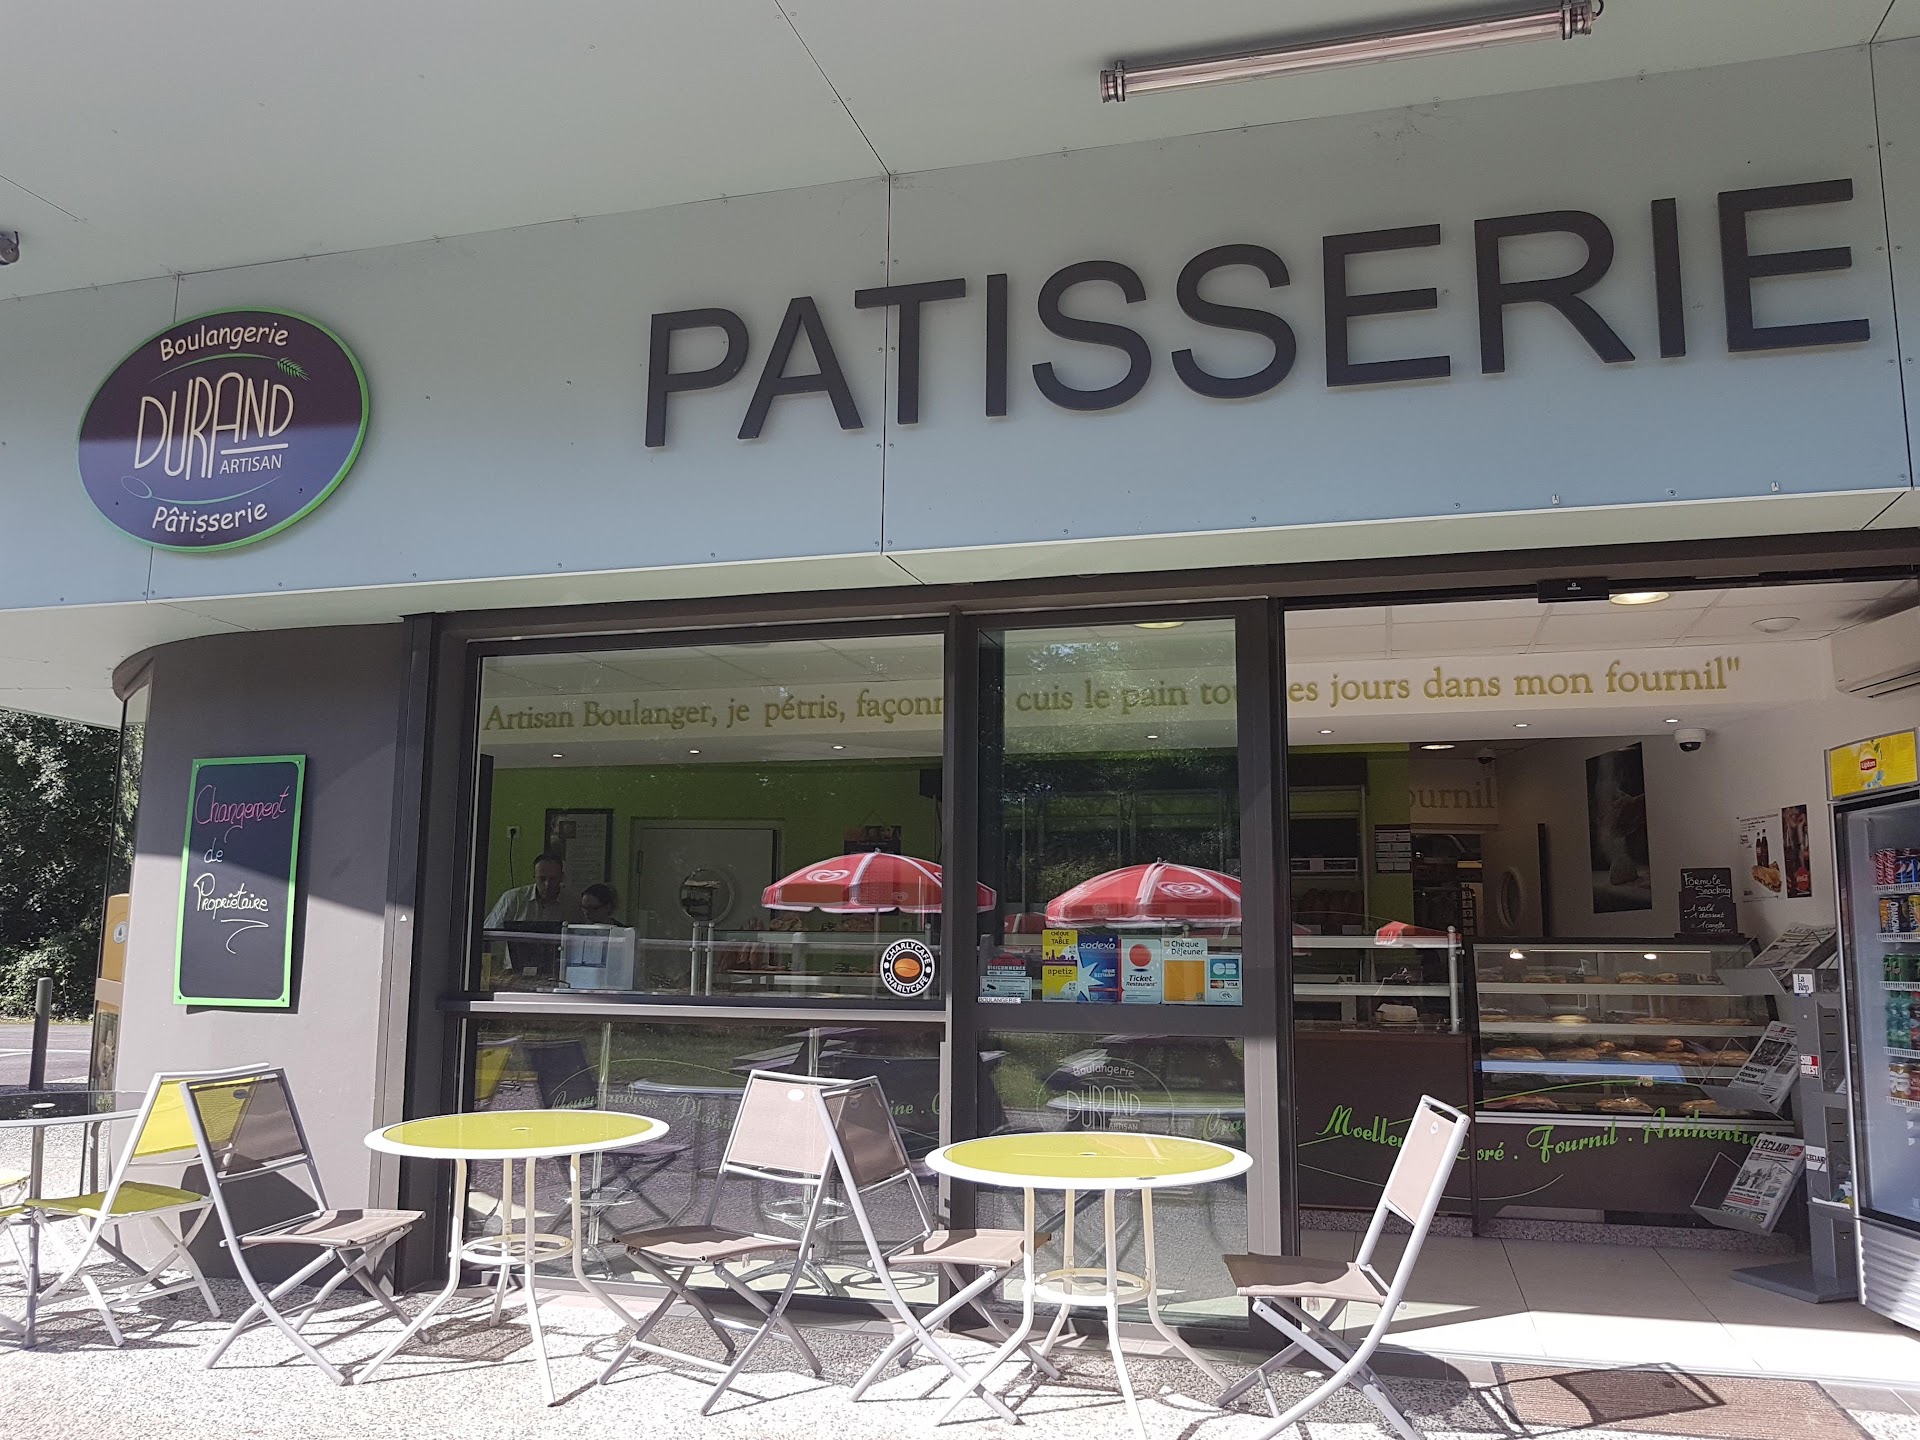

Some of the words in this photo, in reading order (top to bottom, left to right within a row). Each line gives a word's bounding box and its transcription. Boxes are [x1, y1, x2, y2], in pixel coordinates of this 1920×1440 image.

[645, 178, 1870, 448] PATISSERIE
[160, 322, 289, 362] Boulangerie
[134, 372, 294, 480] DURAND
[219, 454, 282, 474] ARTISAN
[152, 502, 268, 533] Pâtisserie
[482, 706, 574, 731] Artisan
[583, 698, 717, 730] Boulanger,
[727, 700, 750, 728] je
[765, 694, 845, 727] pétris,
[1016, 685, 1073, 712] cuis
[1085, 679, 1110, 709] le
[1121, 680, 1189, 715] pain
[1200, 683, 1236, 705] to
[1330, 673, 1410, 708] jours
[1423, 666, 1500, 699] dans
[1513, 672, 1594, 696] mon
[1605, 656, 1740, 694] fournil"
[1860, 760, 1876, 770] Lipton
[195, 785, 290, 830] Changement
[204, 838, 224, 863] de
[194, 873, 269, 919] Propriétaire
[885, 941, 931, 965] CHARLYCAFE
[1080, 939, 1116, 950] sodexo
[1171, 940, 1200, 949] Chèque
[1171, 948, 1205, 957] Déjeuner
[1047, 967, 1073, 976] apetiz
[1128, 974, 1153, 983] Ticket
[1797, 973, 1805, 983] La
[884, 972, 930, 993] CHARLYCAFE
[1072, 1062, 1135, 1078] Boulangerie
[1800, 1055, 1813, 1065] SUD
[1800, 1065, 1819, 1076] OUEST
[1067, 1085, 1140, 1130] DURAND
[1109, 1122, 1138, 1130] ARTISAN
[1526, 1116, 1619, 1164] Fournil
